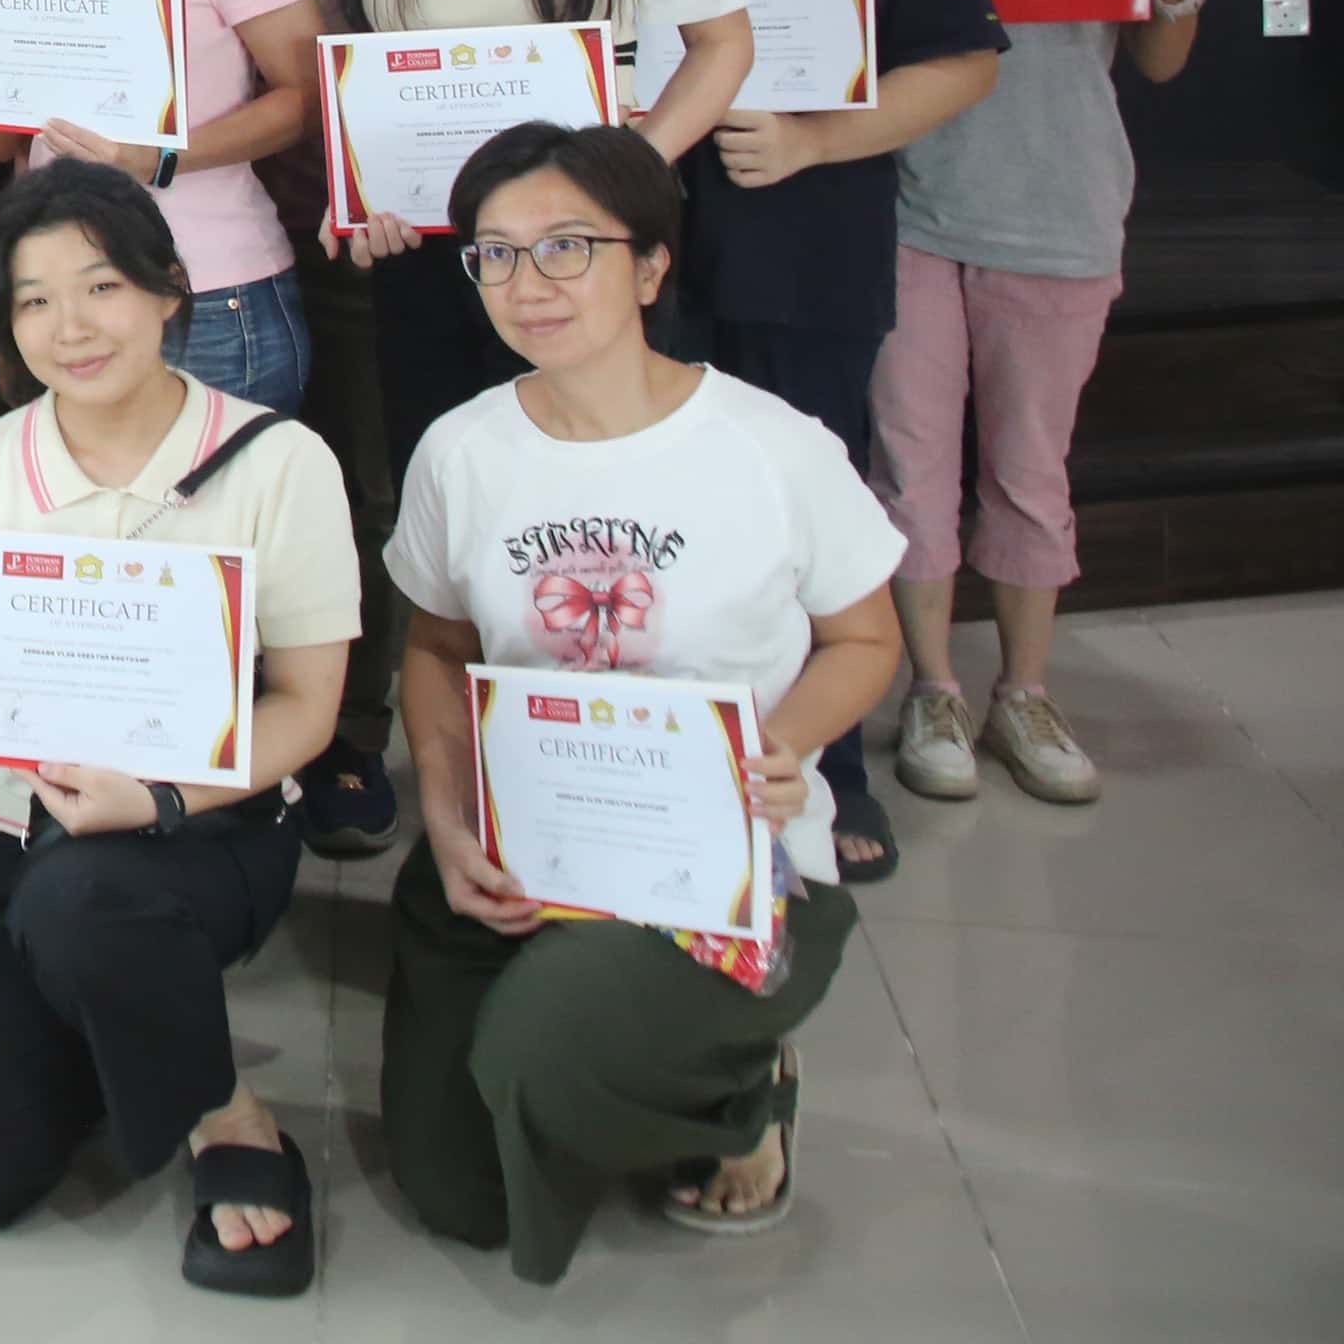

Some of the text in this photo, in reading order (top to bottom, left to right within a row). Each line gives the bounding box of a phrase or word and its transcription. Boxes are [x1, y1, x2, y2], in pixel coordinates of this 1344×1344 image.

[399, 79, 531, 104] CERTIFICATE
[11, 594, 160, 623] CERTIFICATE
[539, 737, 672, 769] CERTIFICATE
